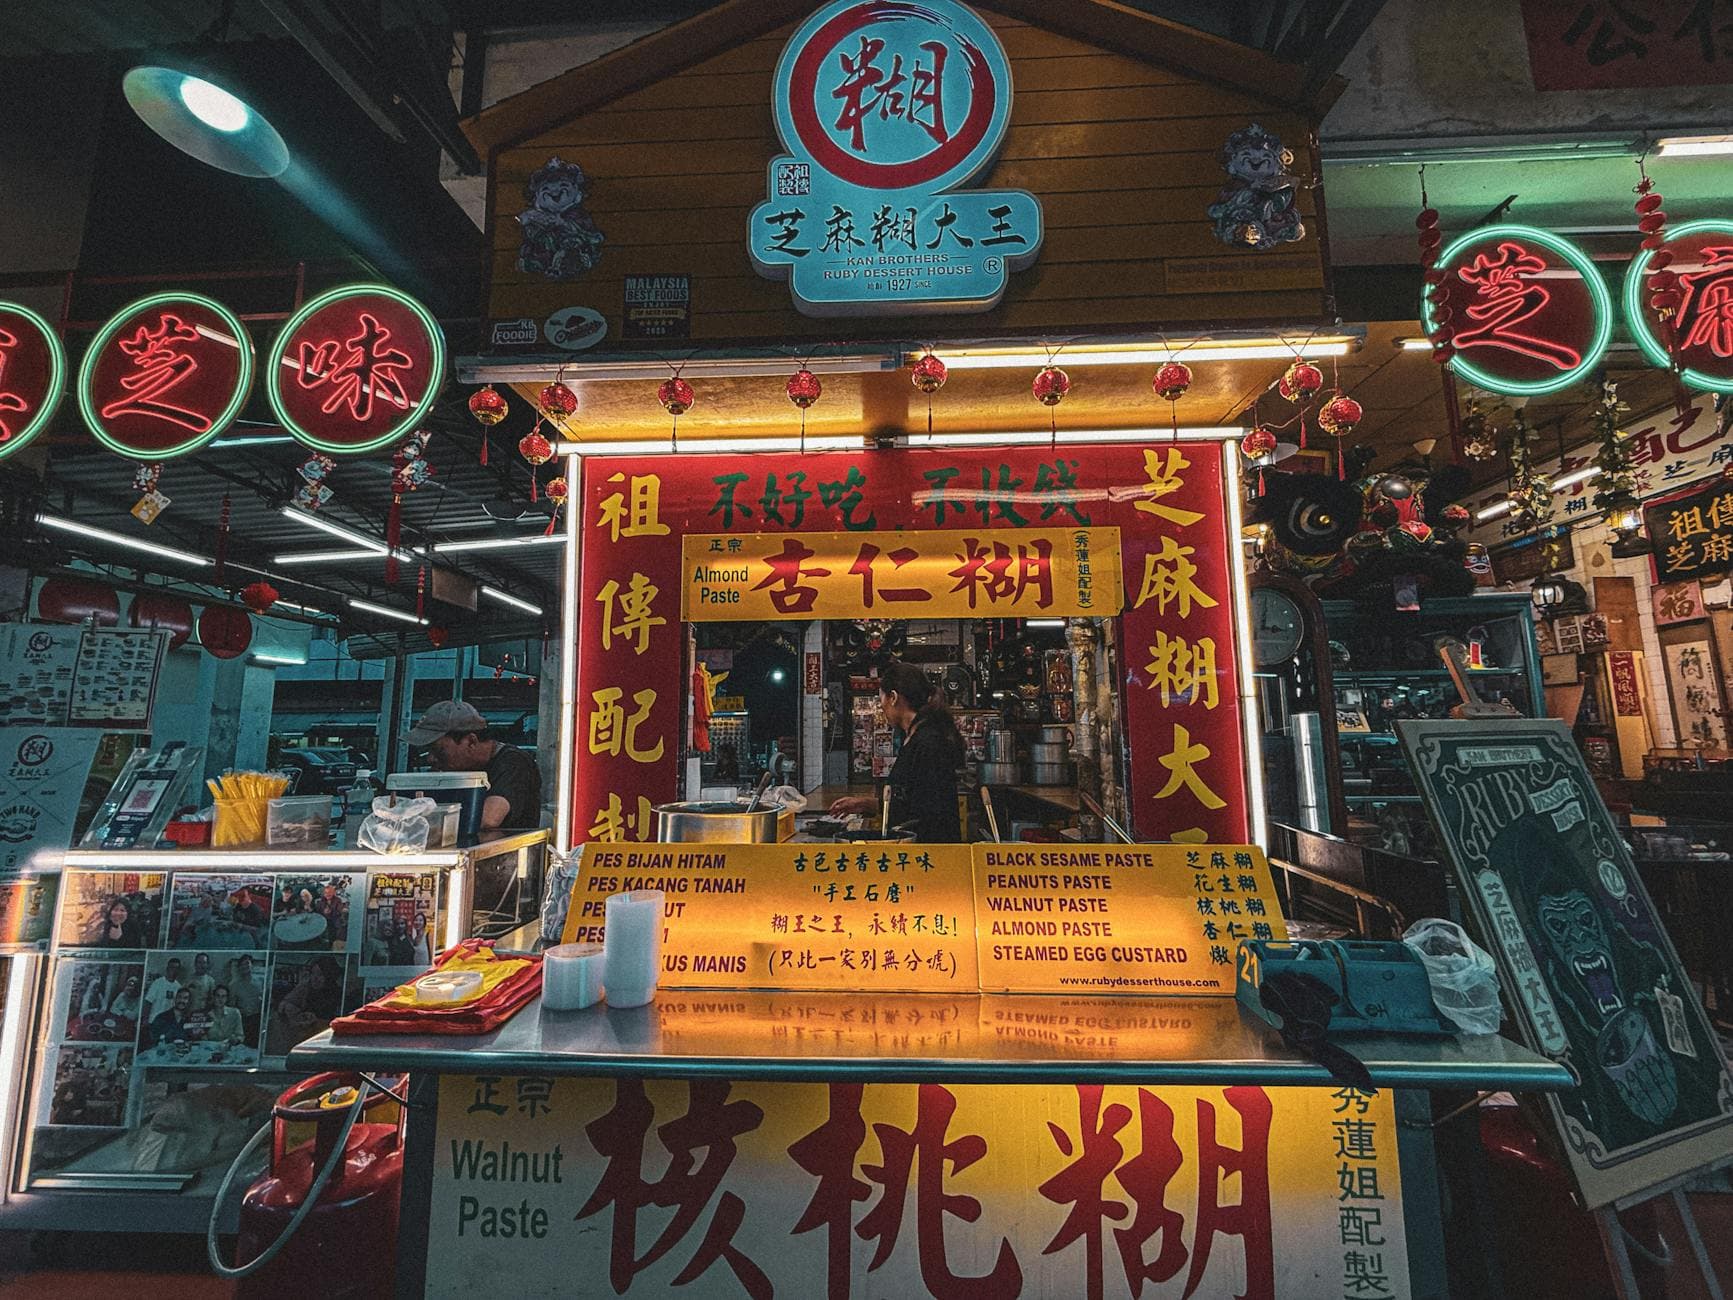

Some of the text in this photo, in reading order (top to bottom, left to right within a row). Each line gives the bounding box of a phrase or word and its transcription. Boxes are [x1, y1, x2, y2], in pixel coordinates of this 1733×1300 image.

[831, 36, 950, 152] 糊
[764, 203, 1028, 257] 芝麻糊大王
[847, 254, 949, 267] KAN BROTHERS
[824, 264, 973, 280] RUBY DESSERT HOUSE
[626, 277, 689, 289] MALAYSIA
[887, 279, 912, 291] 1927
[914, 281, 932, 289] SINCE
[627, 290, 688, 300] BEST FOODS
[495, 330, 535, 341] FOODIE
[708, 466, 878, 531] 不好吃
[708, 538, 743, 553] 正宗
[694, 565, 749, 583] Almond
[750, 536, 1054, 613] 杏仁糊
[701, 587, 740, 604] Paste
[1133, 447, 1228, 842] 芝麻糊大
[593, 852, 726, 869] PES BIJAN HITAM
[793, 852, 935, 873] 古色古香古早味
[986, 852, 1154, 867] BLACK SESAME PASTE
[1186, 851, 1254, 870] 芝麻糊
[587, 876, 746, 893] PES KACANG TANAH
[988, 874, 1112, 890] PEANUTS PASTE
[1193, 873, 1258, 893] 花生糊
[581, 901, 606, 918] PE
[987, 897, 1109, 913] WALNUT PASTE
[1196, 896, 1266, 917] 核桃糊
[991, 921, 1113, 937] ALMOND PASTE
[1202, 920, 1274, 940] 杏仁糊
[993, 945, 1188, 963] STEAMED EGG CUSTARD
[692, 955, 747, 973] MANIS
[1059, 976, 1220, 988] www.rubydesserthouse.com
[466, 1075, 556, 1118] 正宗
[451, 1139, 563, 1184] Walnut
[573, 1081, 1275, 1300] 核桃糊
[458, 1196, 549, 1239] Paste
